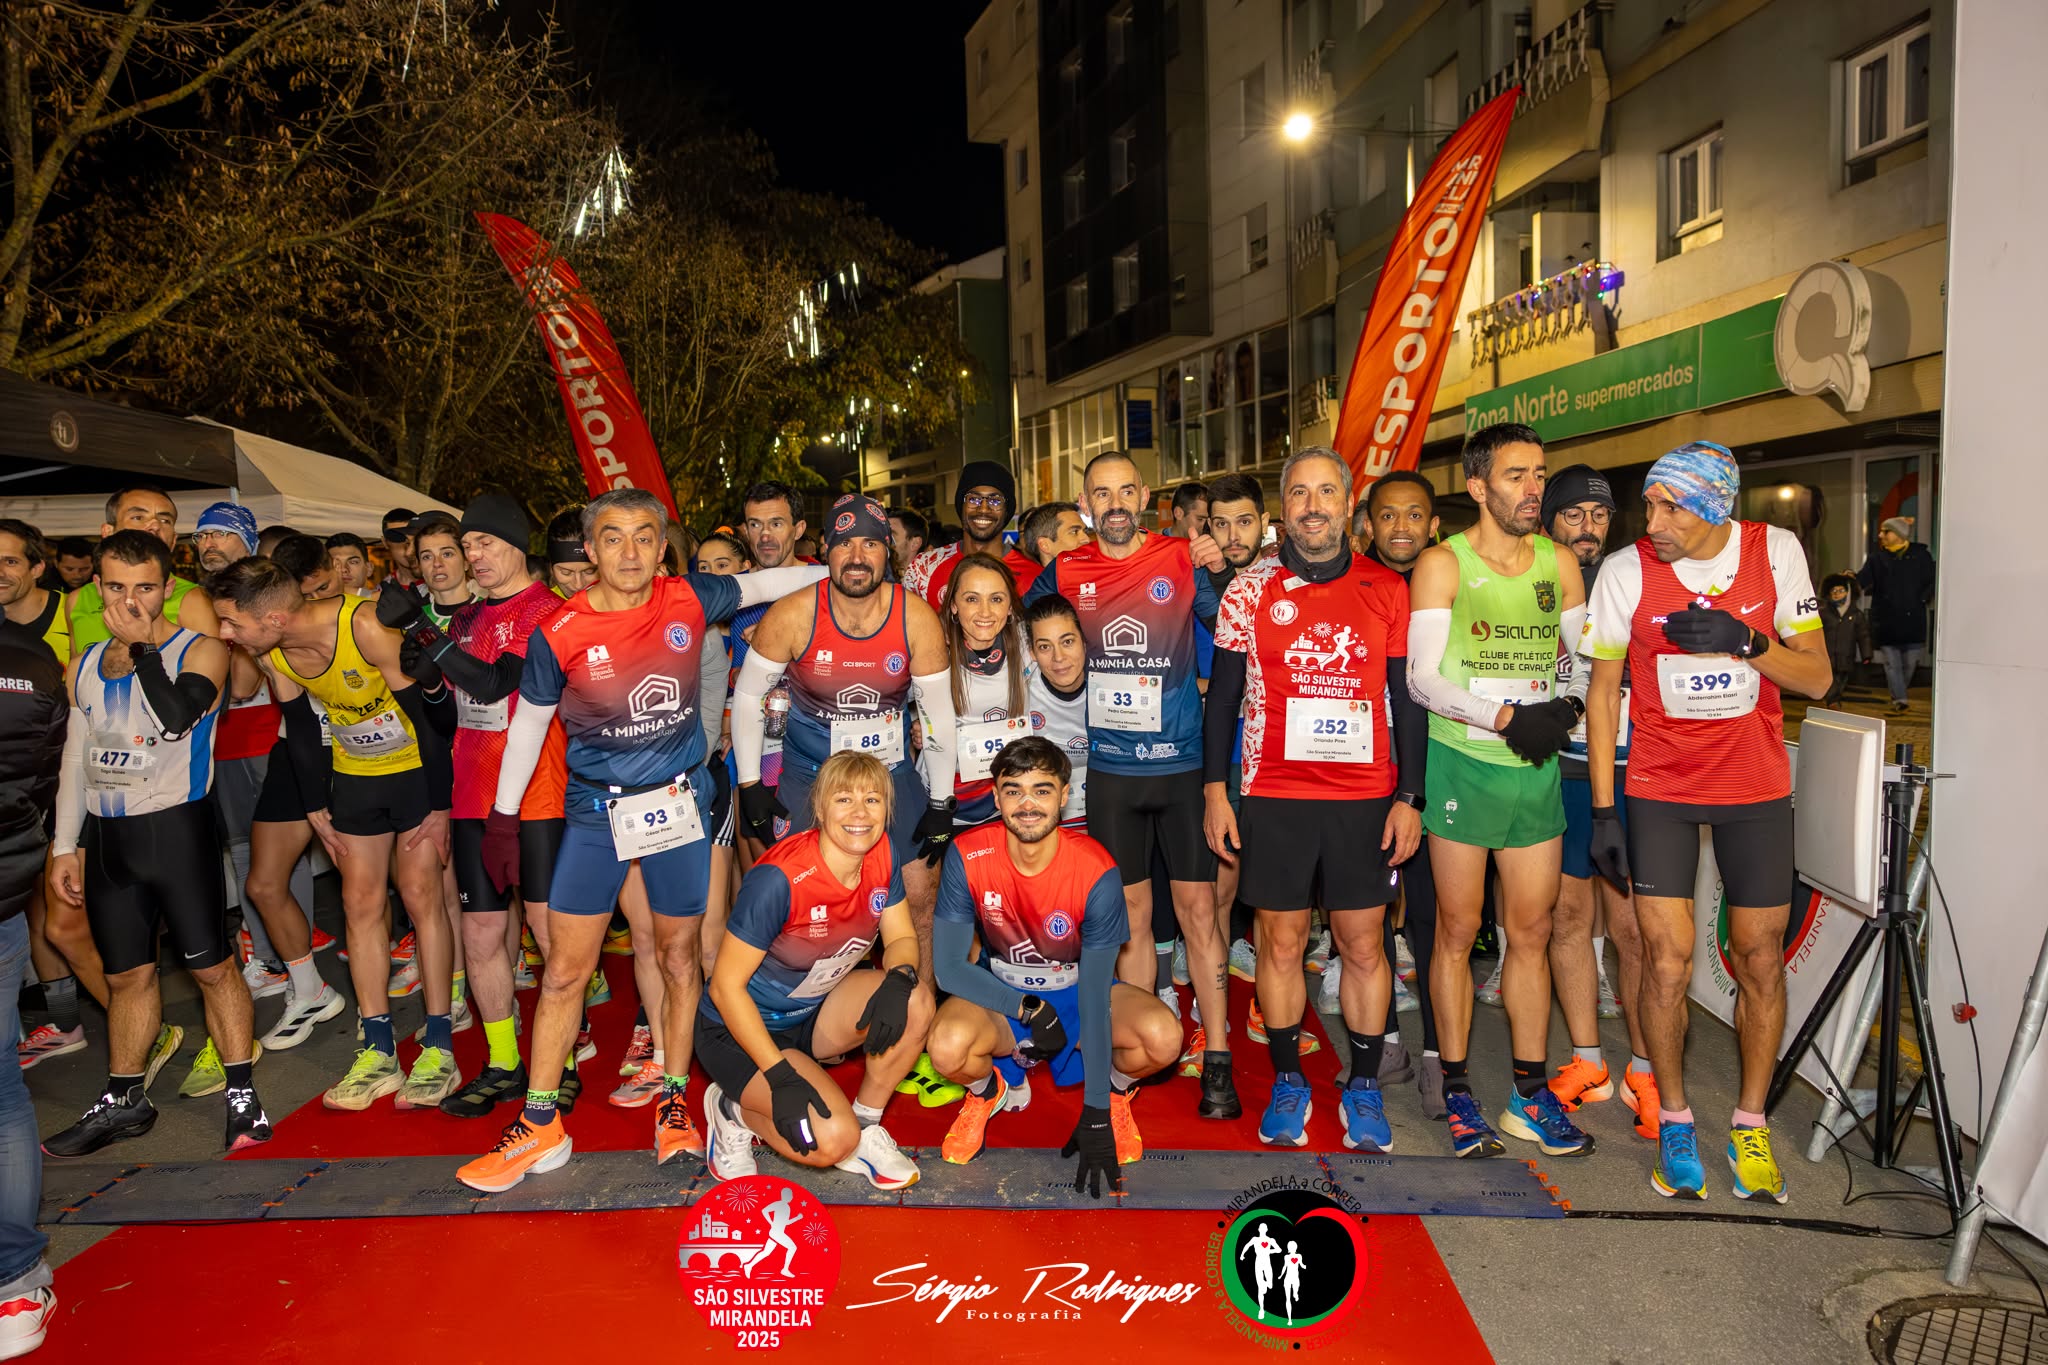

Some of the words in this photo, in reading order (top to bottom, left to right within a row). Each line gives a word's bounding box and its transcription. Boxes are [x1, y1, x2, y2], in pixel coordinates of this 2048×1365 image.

[1358, 217, 1458, 502] ESPORTO
[1466, 404, 1509, 440] Zona
[1513, 384, 1569, 428] Norte
[1574, 363, 1694, 411] supermercados
[1096, 658, 1134, 668] MINHA
[1138, 657, 1171, 668] CASA
[1480, 651, 1510, 660] CLUBE
[1513, 651, 1552, 660] ATLÉTICO
[1461, 660, 1499, 670] MACEDO
[1291, 672, 1310, 684] SÃO
[1312, 675, 1362, 688] SILVESTRE
[1690, 673, 1732, 692] 399
[1114, 692, 1132, 706] 33
[1299, 685, 1354, 698] MIRANDELA
[615, 717, 665, 738] MINHA
[1313, 719, 1348, 734] 252
[353, 732, 384, 745] 524
[861, 734, 880, 748] 88
[984, 738, 1004, 753] 95
[100, 751, 130, 767] 477
[644, 809, 668, 827] 93
[1707, 918, 1732, 994] MIRANDELA
[831, 963, 852, 978] 87
[1024, 977, 1046, 985] 89
